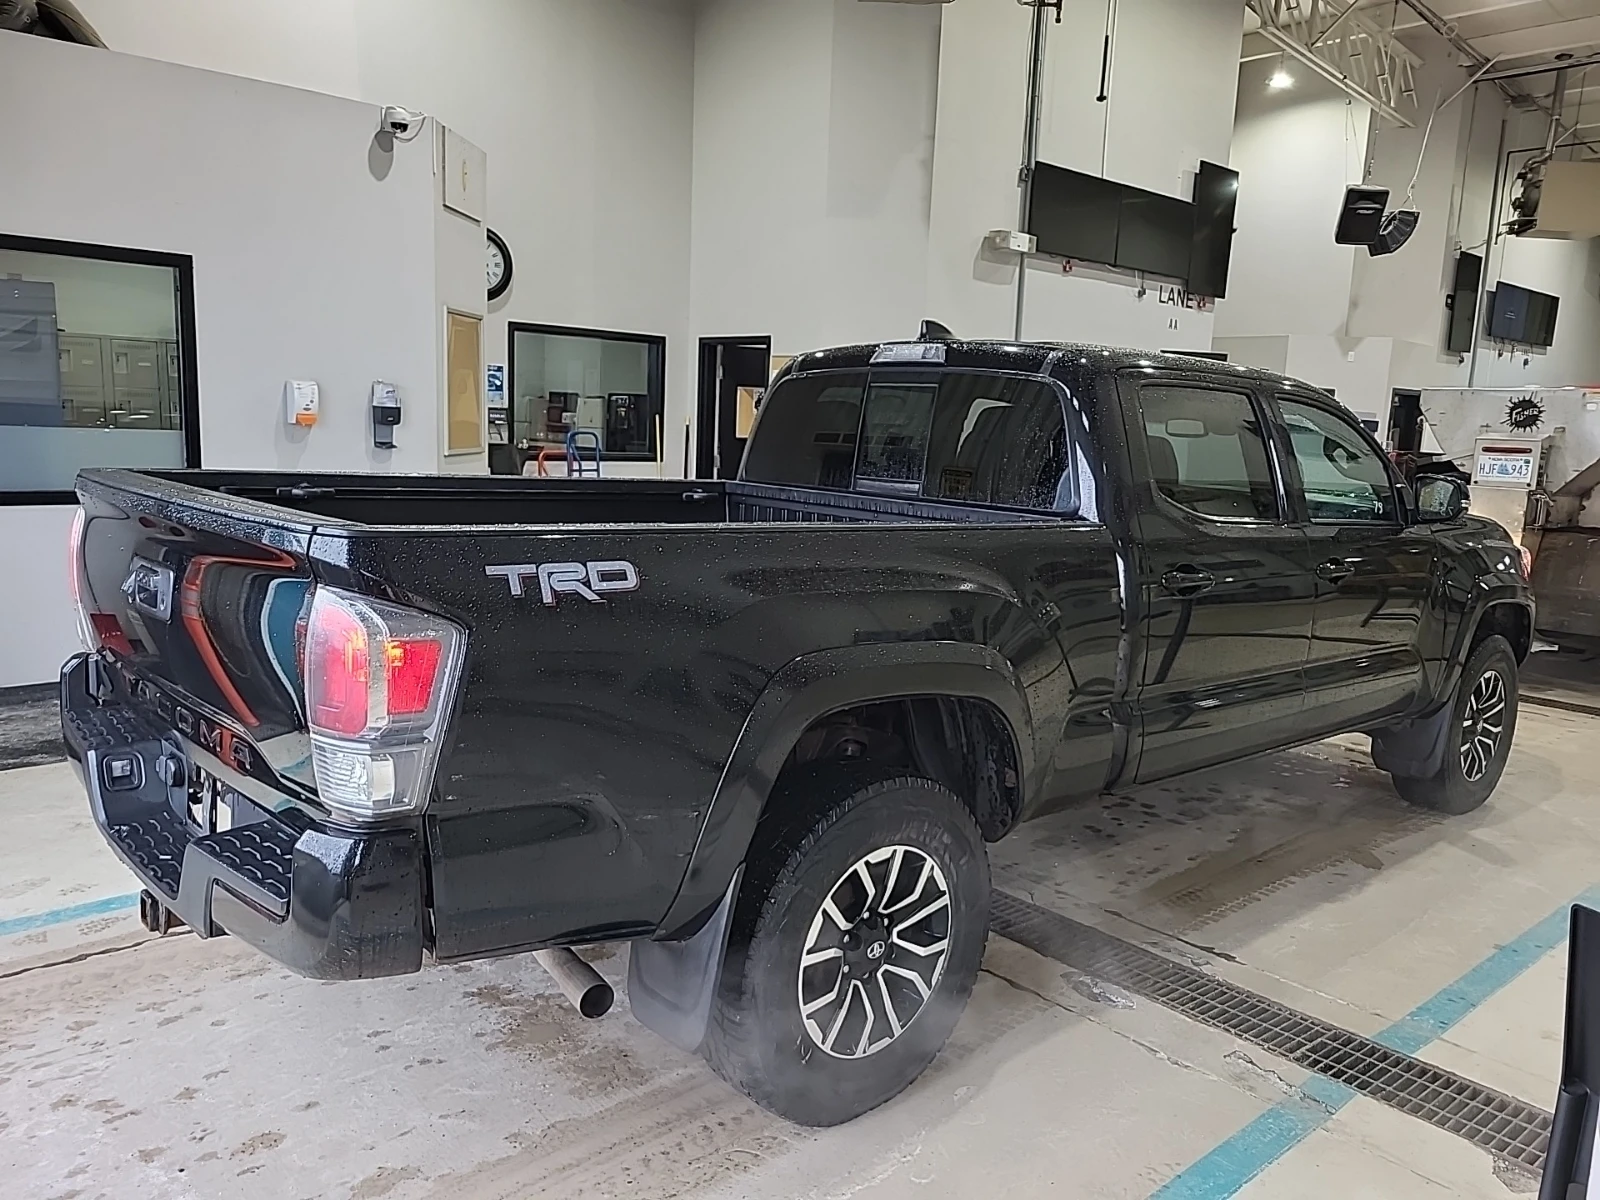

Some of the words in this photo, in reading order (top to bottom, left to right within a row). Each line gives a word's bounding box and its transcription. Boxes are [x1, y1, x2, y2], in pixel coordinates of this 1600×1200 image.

[1159, 285, 1193, 309] LANE
[1512, 407, 1539, 423] FISHER
[1479, 463, 1498, 475] HJF
[1510, 464, 1530, 476] 943
[485, 560, 638, 604] TRD
